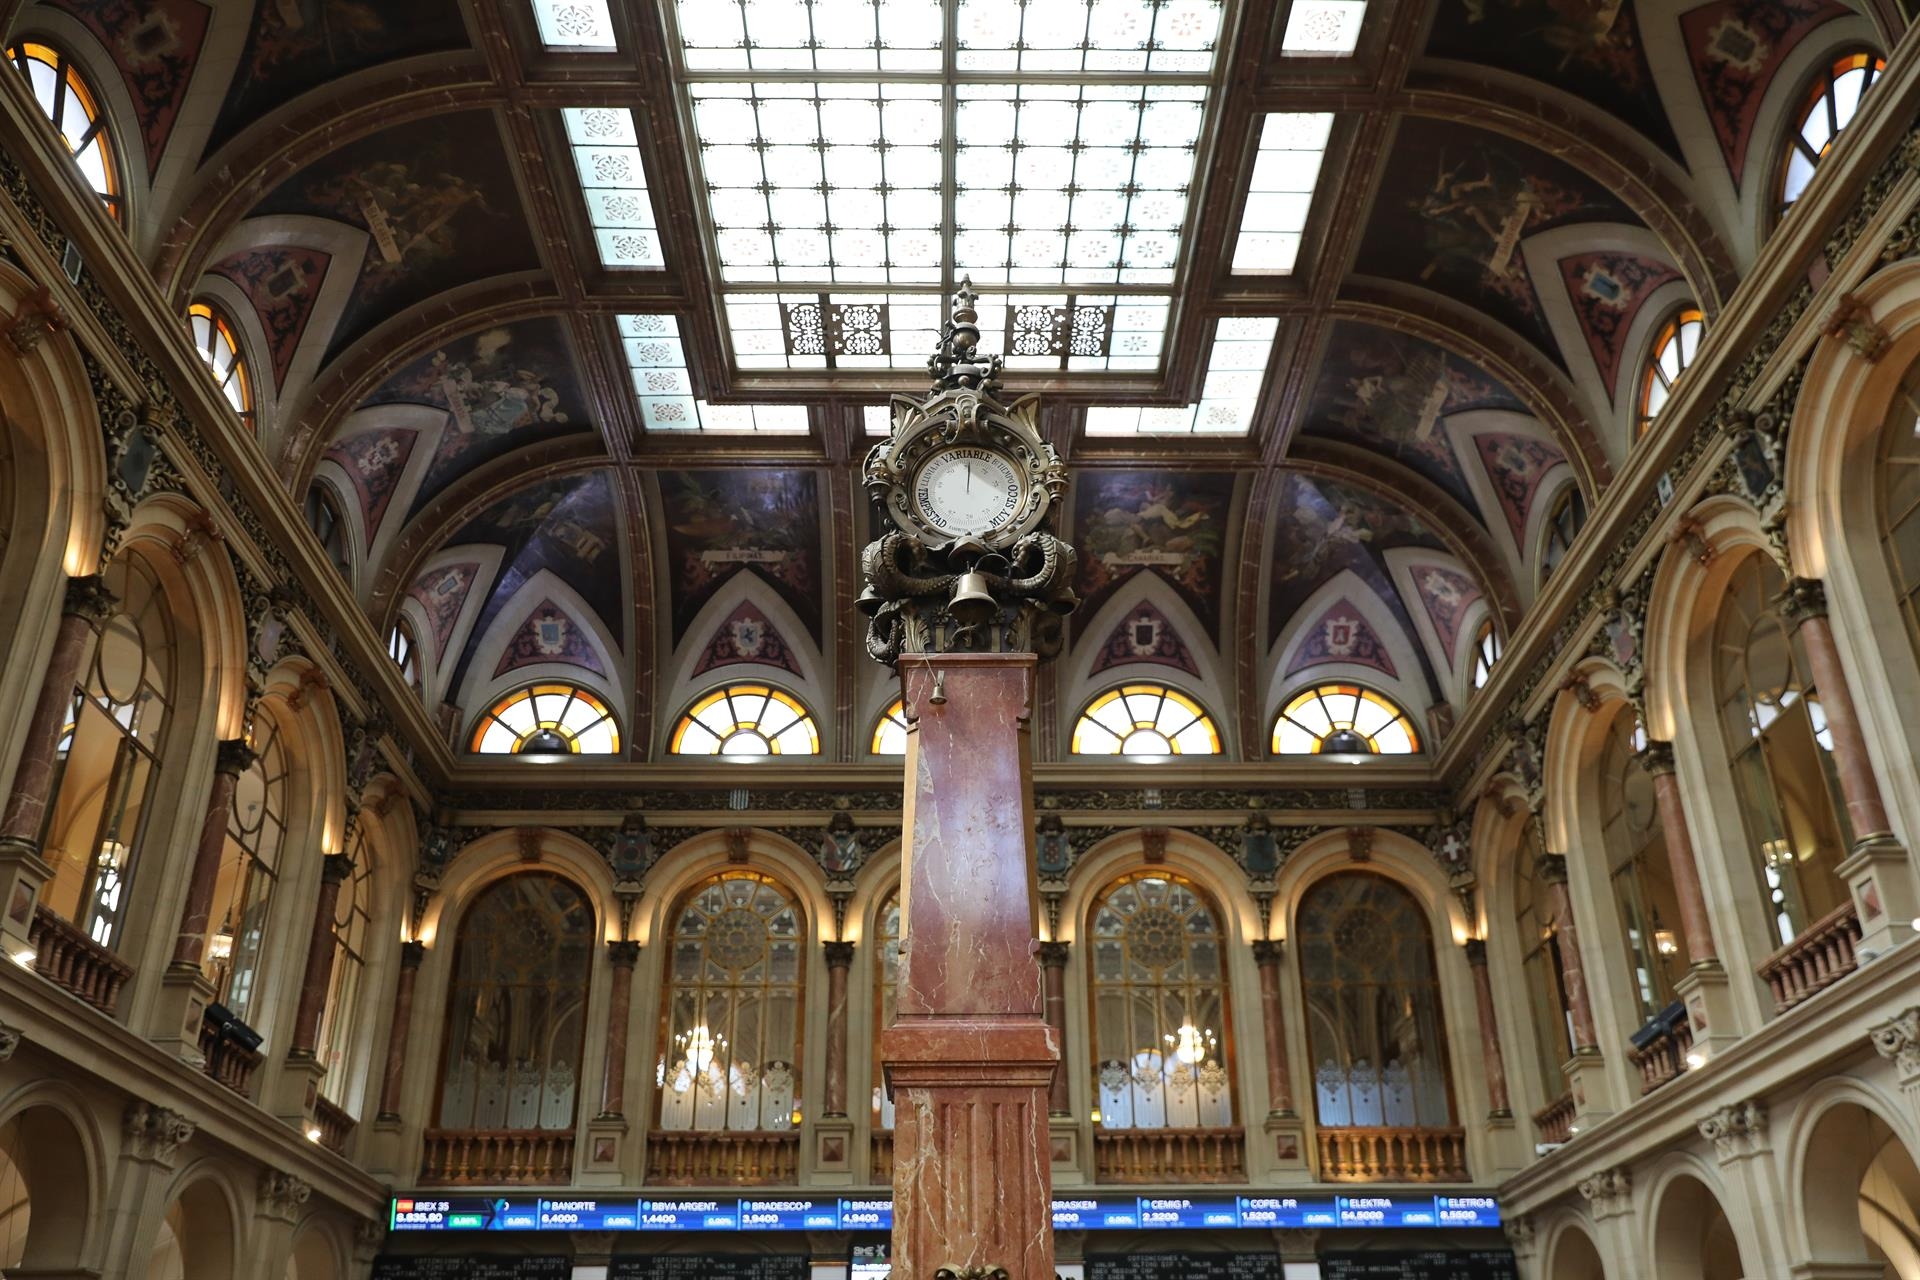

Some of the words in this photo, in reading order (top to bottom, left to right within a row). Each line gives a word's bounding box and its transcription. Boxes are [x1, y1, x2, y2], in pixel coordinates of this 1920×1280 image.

[940, 450, 992, 463] VARIABLE
[918, 488, 947, 528] TEMPESTAD
[988, 508, 1010, 528] MUY
[1006, 484, 1018, 510] SECO
[415, 1202, 436, 1212] IBEX
[438, 1202, 450, 1212] 35
[552, 1202, 596, 1211] BANORTE
[652, 1202, 676, 1212] BBVA
[677, 1202, 718, 1212] ARGENT.
[1052, 1200, 1097, 1210] BRASKEM
[1151, 1200, 1181, 1210] CEMIG
[1250, 1199, 1282, 1209] COPEL
[1350, 1198, 1392, 1209] ELEKTRA
[642, 1214, 676, 1224] 1,4400
